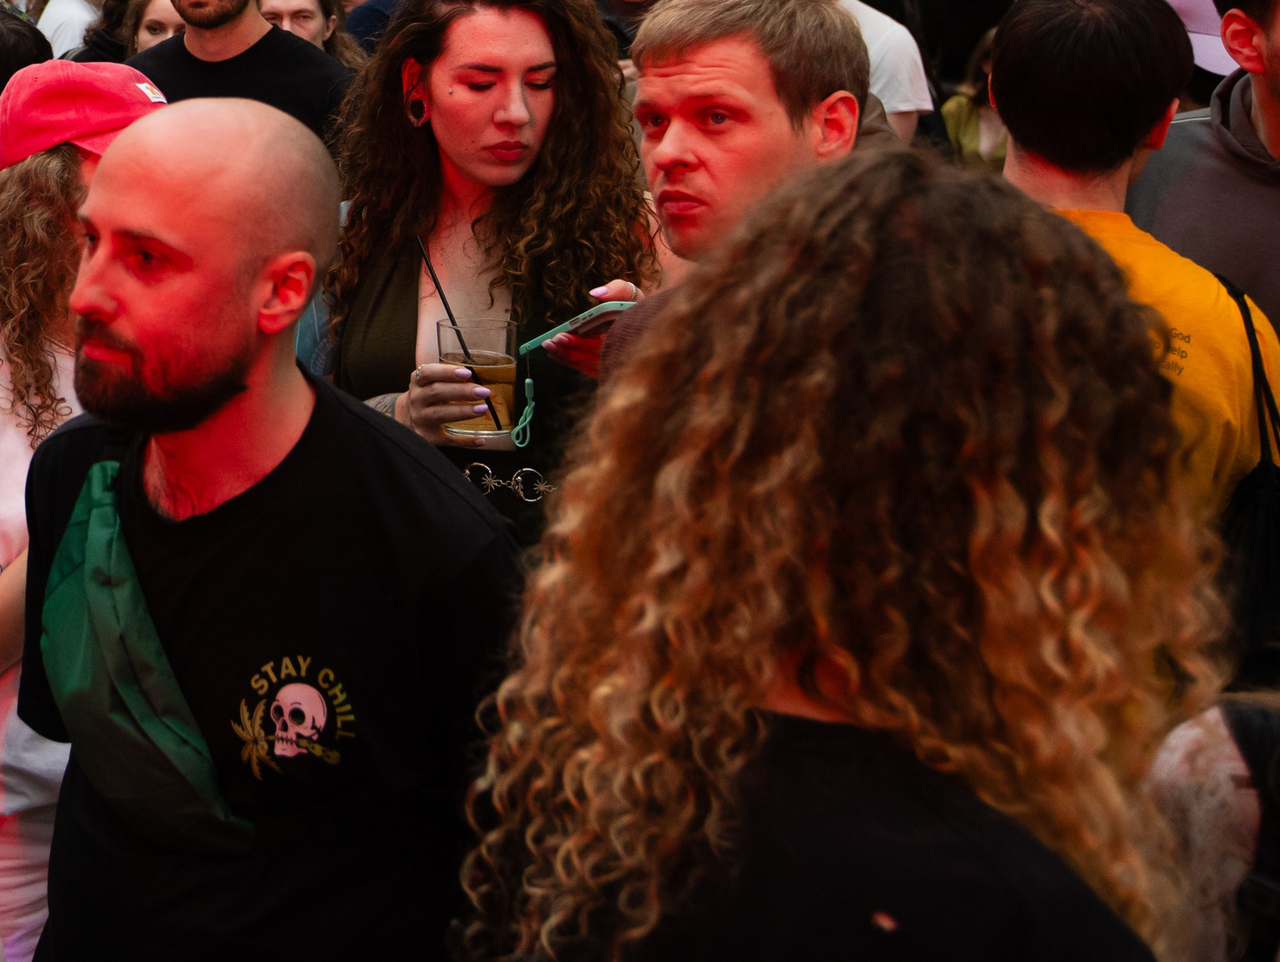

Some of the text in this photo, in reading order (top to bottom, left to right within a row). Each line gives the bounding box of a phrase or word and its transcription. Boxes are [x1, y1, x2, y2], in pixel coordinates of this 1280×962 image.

[1170, 327, 1191, 344] God
[1167, 345, 1188, 360] elp
[250, 654, 356, 741] STAY CHILL
